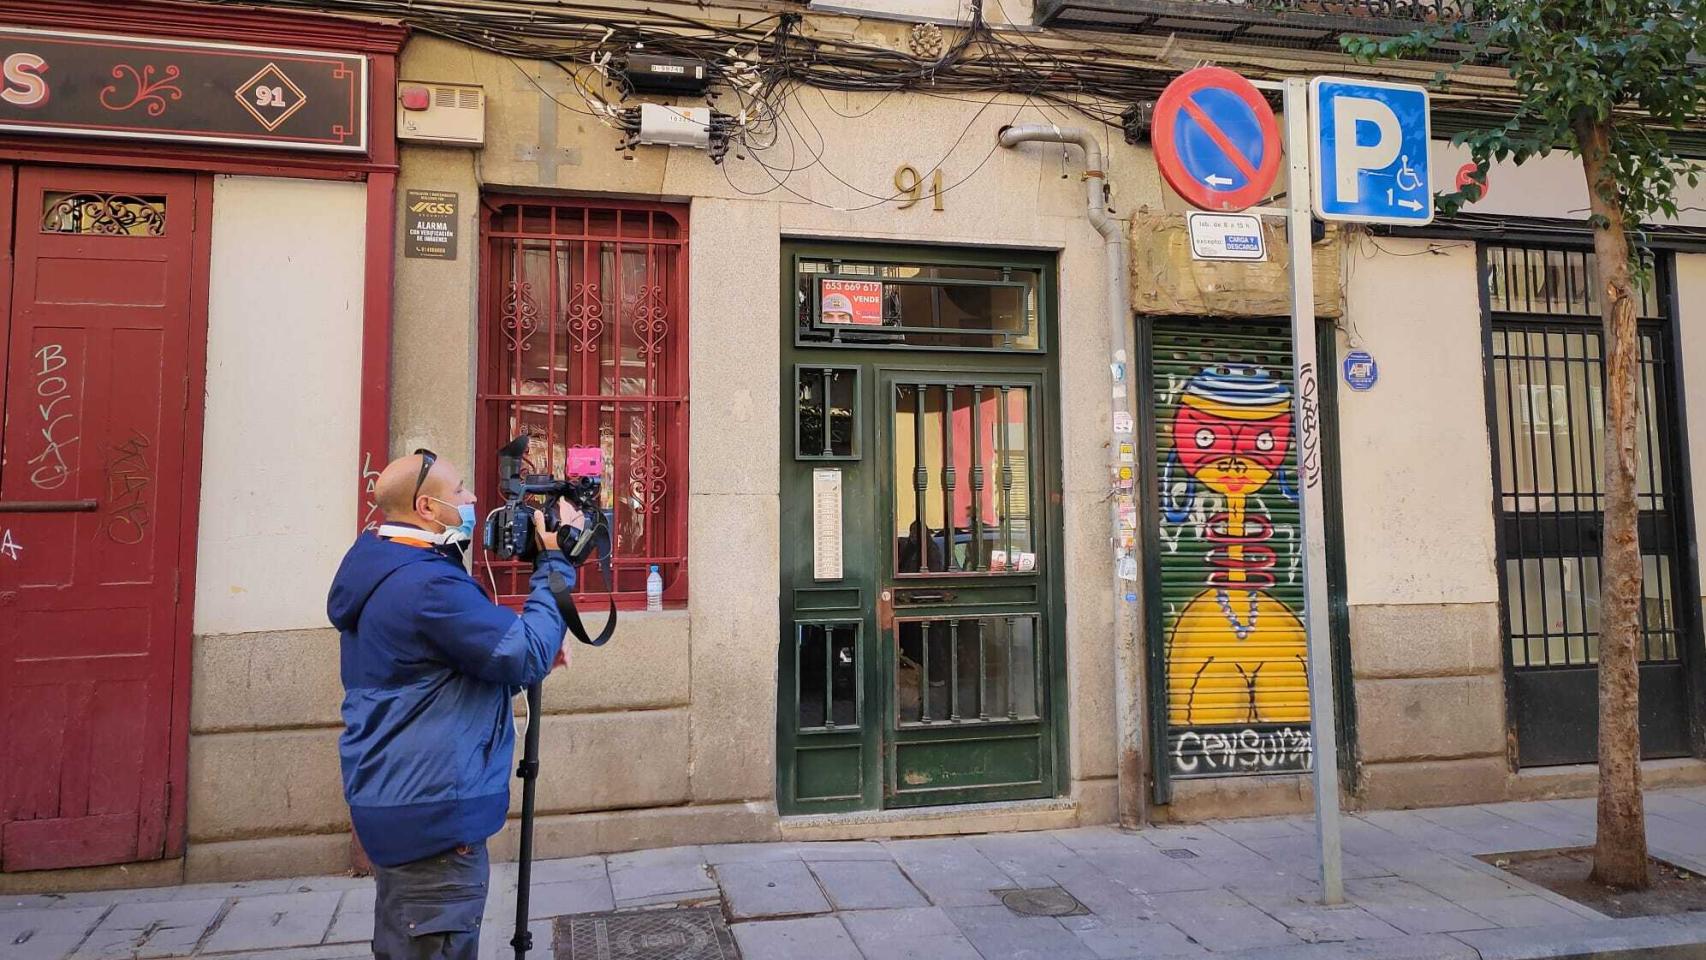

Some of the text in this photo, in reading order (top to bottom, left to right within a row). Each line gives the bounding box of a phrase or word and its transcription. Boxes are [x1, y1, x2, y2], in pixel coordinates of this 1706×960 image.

[1, 53, 48, 107] S
[256, 85, 286, 107] 91
[1334, 96, 1402, 203] P
[895, 164, 944, 211] 91
[1386, 188, 1393, 207] 1
[426, 202, 454, 214] GSS
[417, 221, 448, 231] ALARMA
[825, 282, 880, 292] 653 669 617
[853, 295, 880, 303] VENDE
